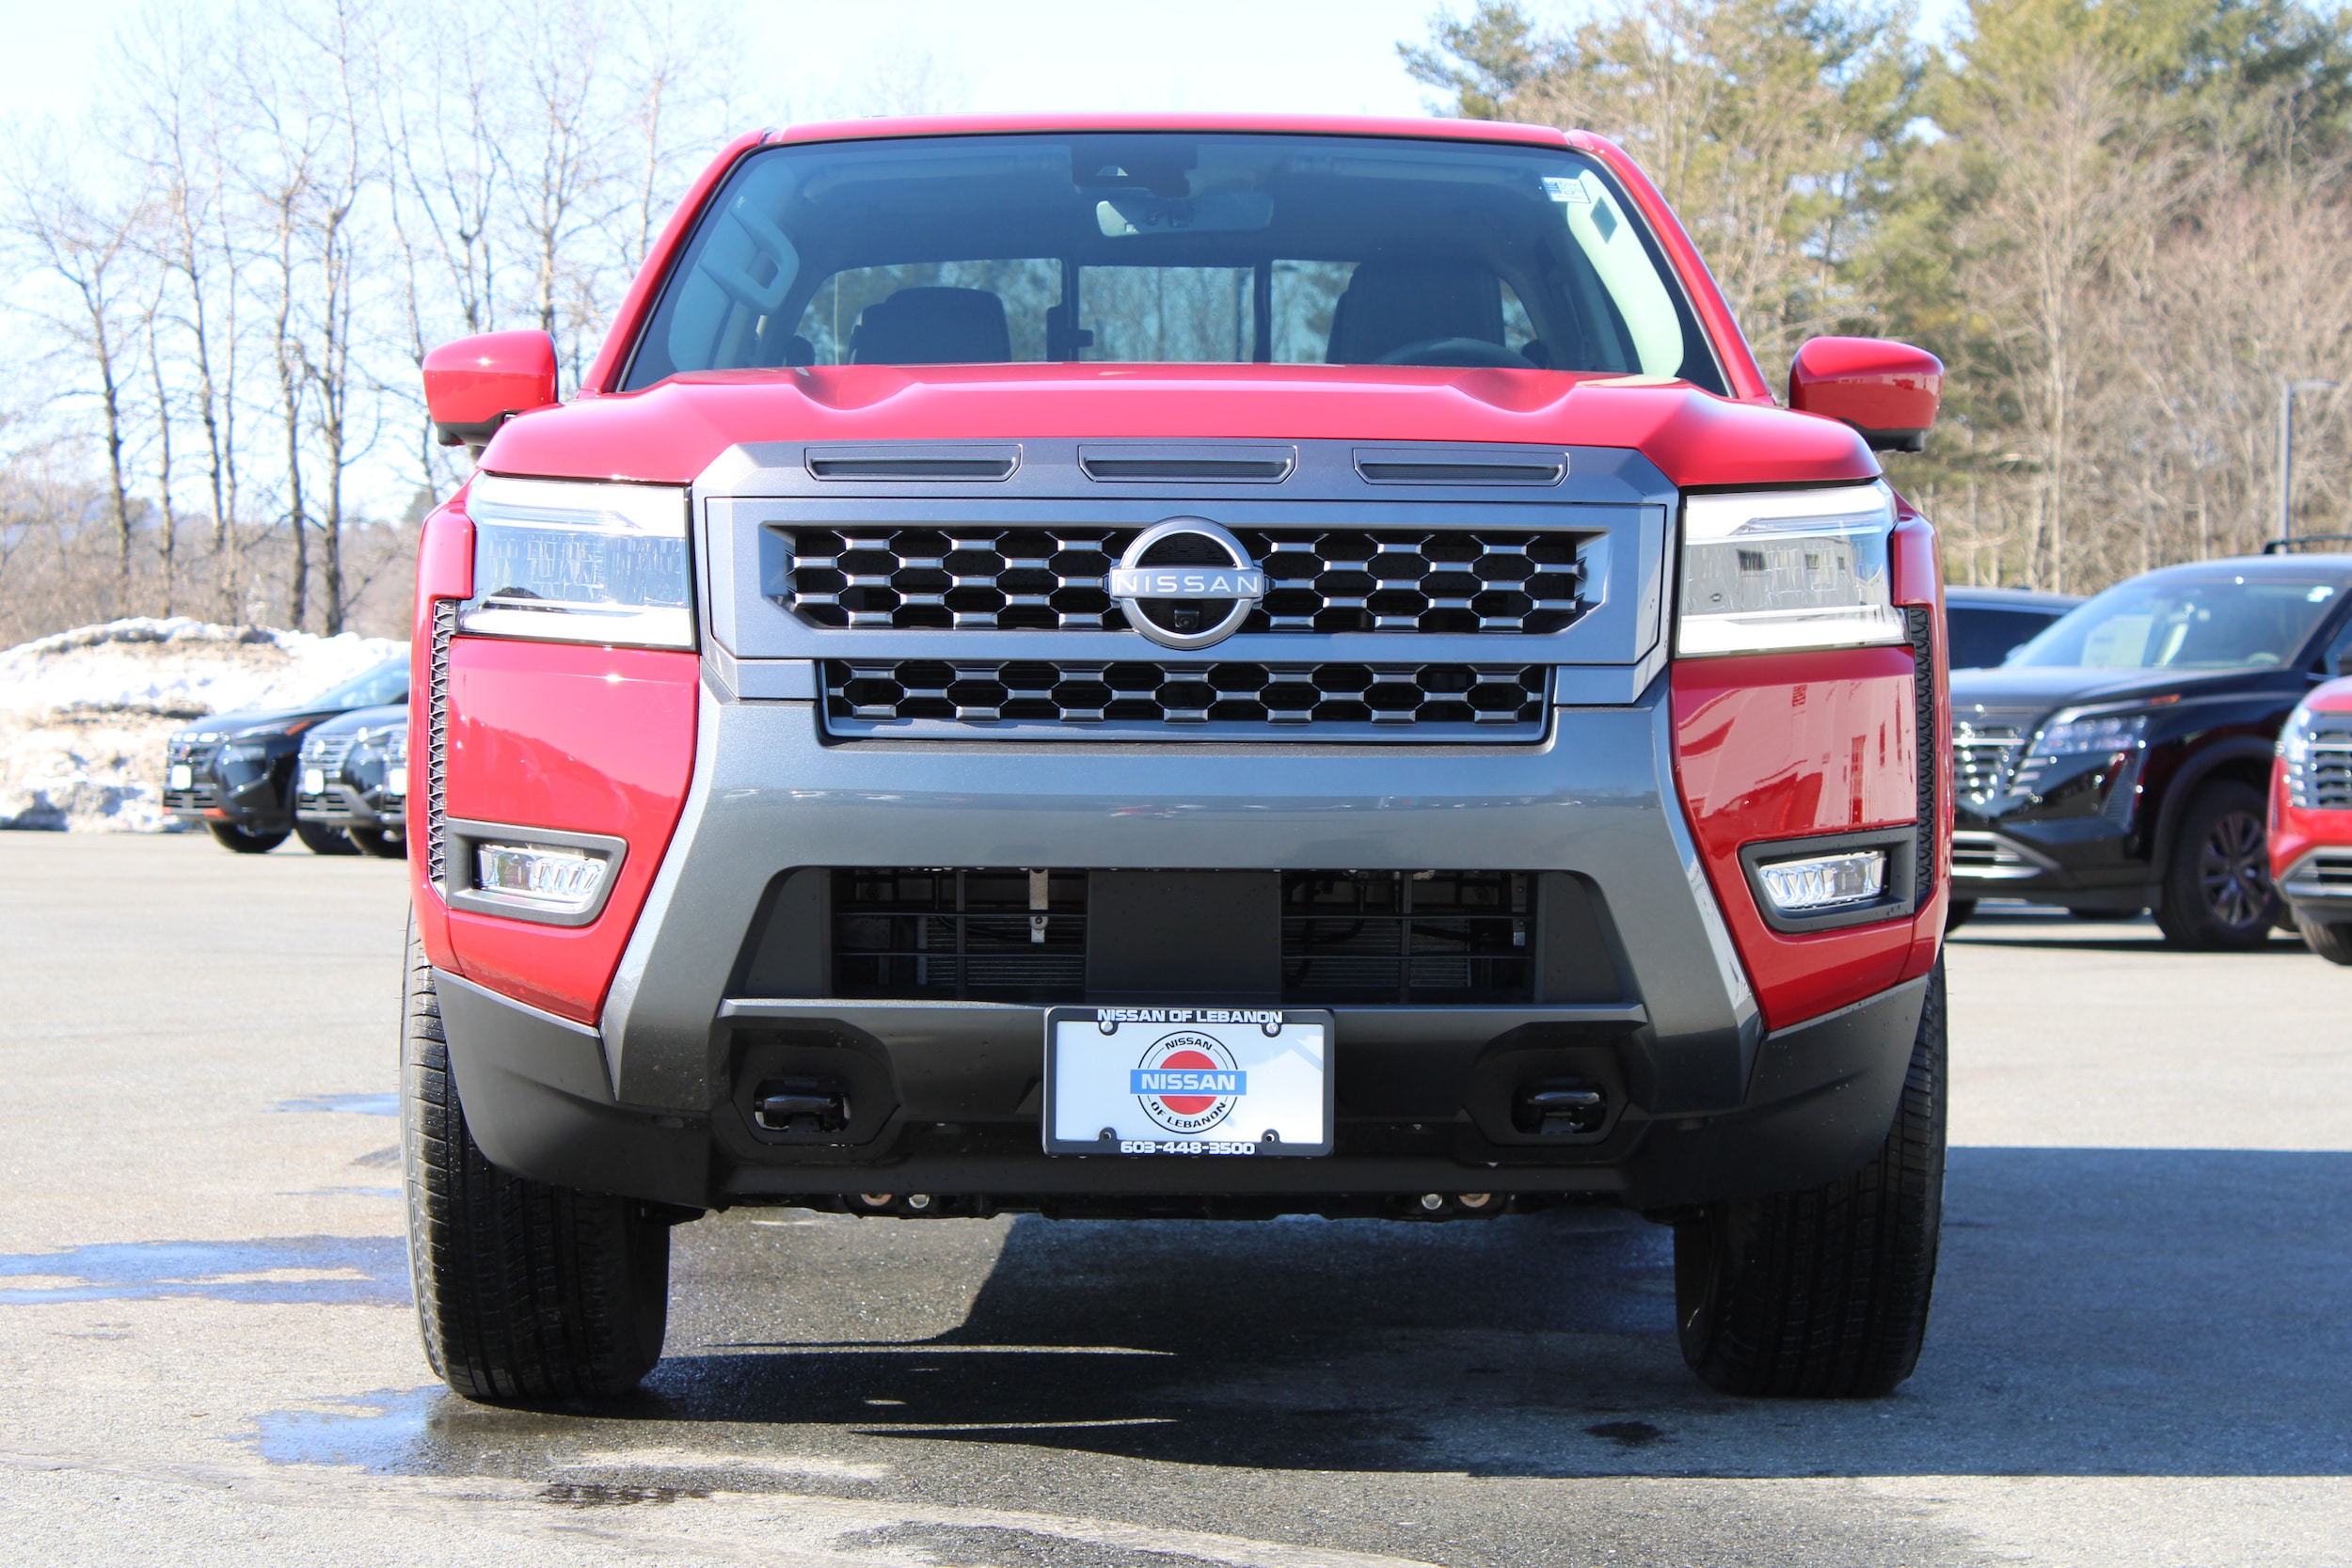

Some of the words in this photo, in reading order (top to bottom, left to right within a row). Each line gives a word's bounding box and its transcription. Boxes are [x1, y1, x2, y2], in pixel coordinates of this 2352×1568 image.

[1116, 575, 1259, 594] NISSAN
[1097, 1009, 1166, 1022] NISSAN
[1168, 1010, 1193, 1022] OF
[1196, 1010, 1283, 1023] LEBANON
[1165, 1037, 1213, 1051] NISSAN
[1141, 1073, 1235, 1091] NISSAN
[1151, 1101, 1167, 1117] OF
[1167, 1101, 1226, 1129] LEBANON
[1120, 1141, 1256, 1155] 603-448-3500
